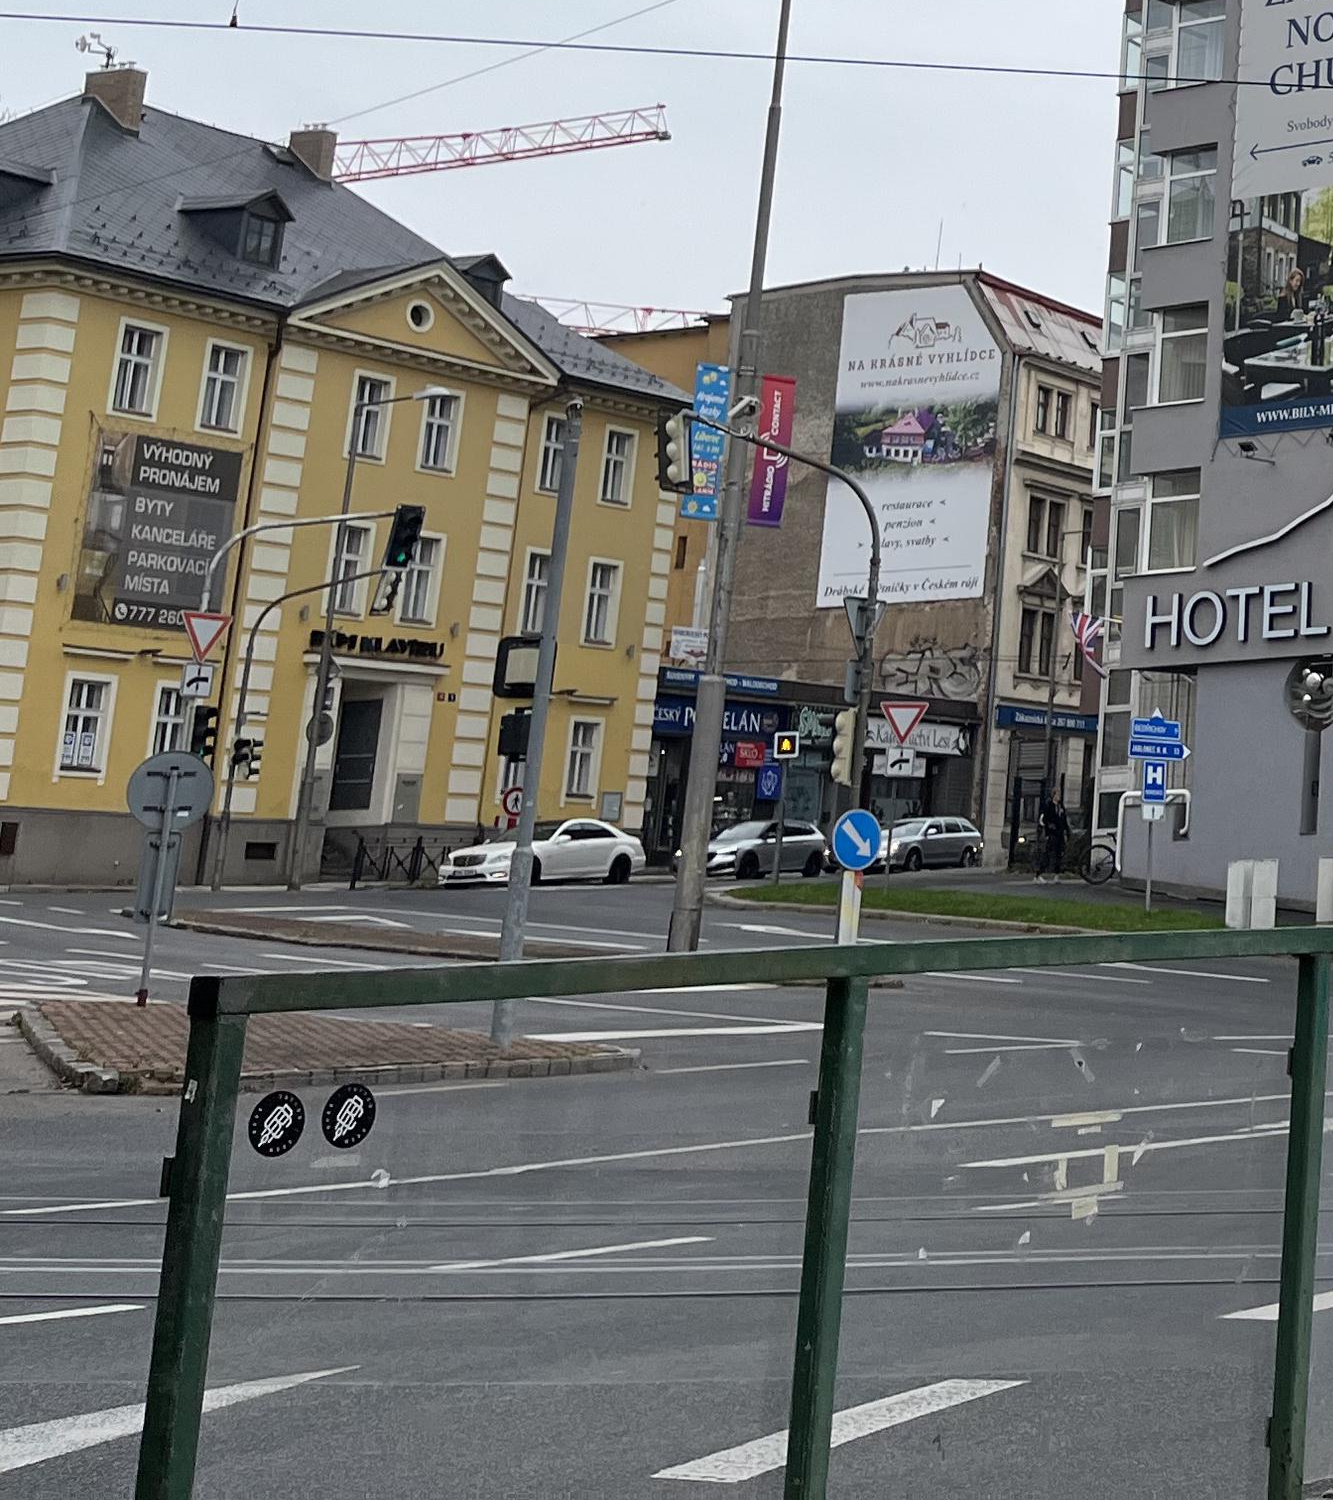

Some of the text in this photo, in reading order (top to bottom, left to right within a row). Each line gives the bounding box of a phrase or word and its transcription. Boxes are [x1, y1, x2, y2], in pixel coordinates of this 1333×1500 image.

[1286, 116, 1333, 132] Svobody
[848, 348, 996, 372] NA KRÁSNÉ VYHLÍDCE
[771, 390, 783, 436] CONTACT
[143, 442, 214, 470] VÝHODNÝ
[139, 465, 221, 494] PRONÁJEM
[134, 497, 174, 517] BYTY
[881, 500, 934, 512] restaurace
[884, 518, 923, 532] penzion
[131, 523, 217, 550] KANCELÁŘE
[905, 534, 937, 549] svatby
[127, 550, 211, 576] PARKOVACÍ
[124, 574, 170, 595] MÍSTA
[921, 577, 958, 591] Českém
[960, 577, 979, 591] ráji
[128, 605, 155, 621] 777
[1144, 580, 1331, 649] HOTEL
